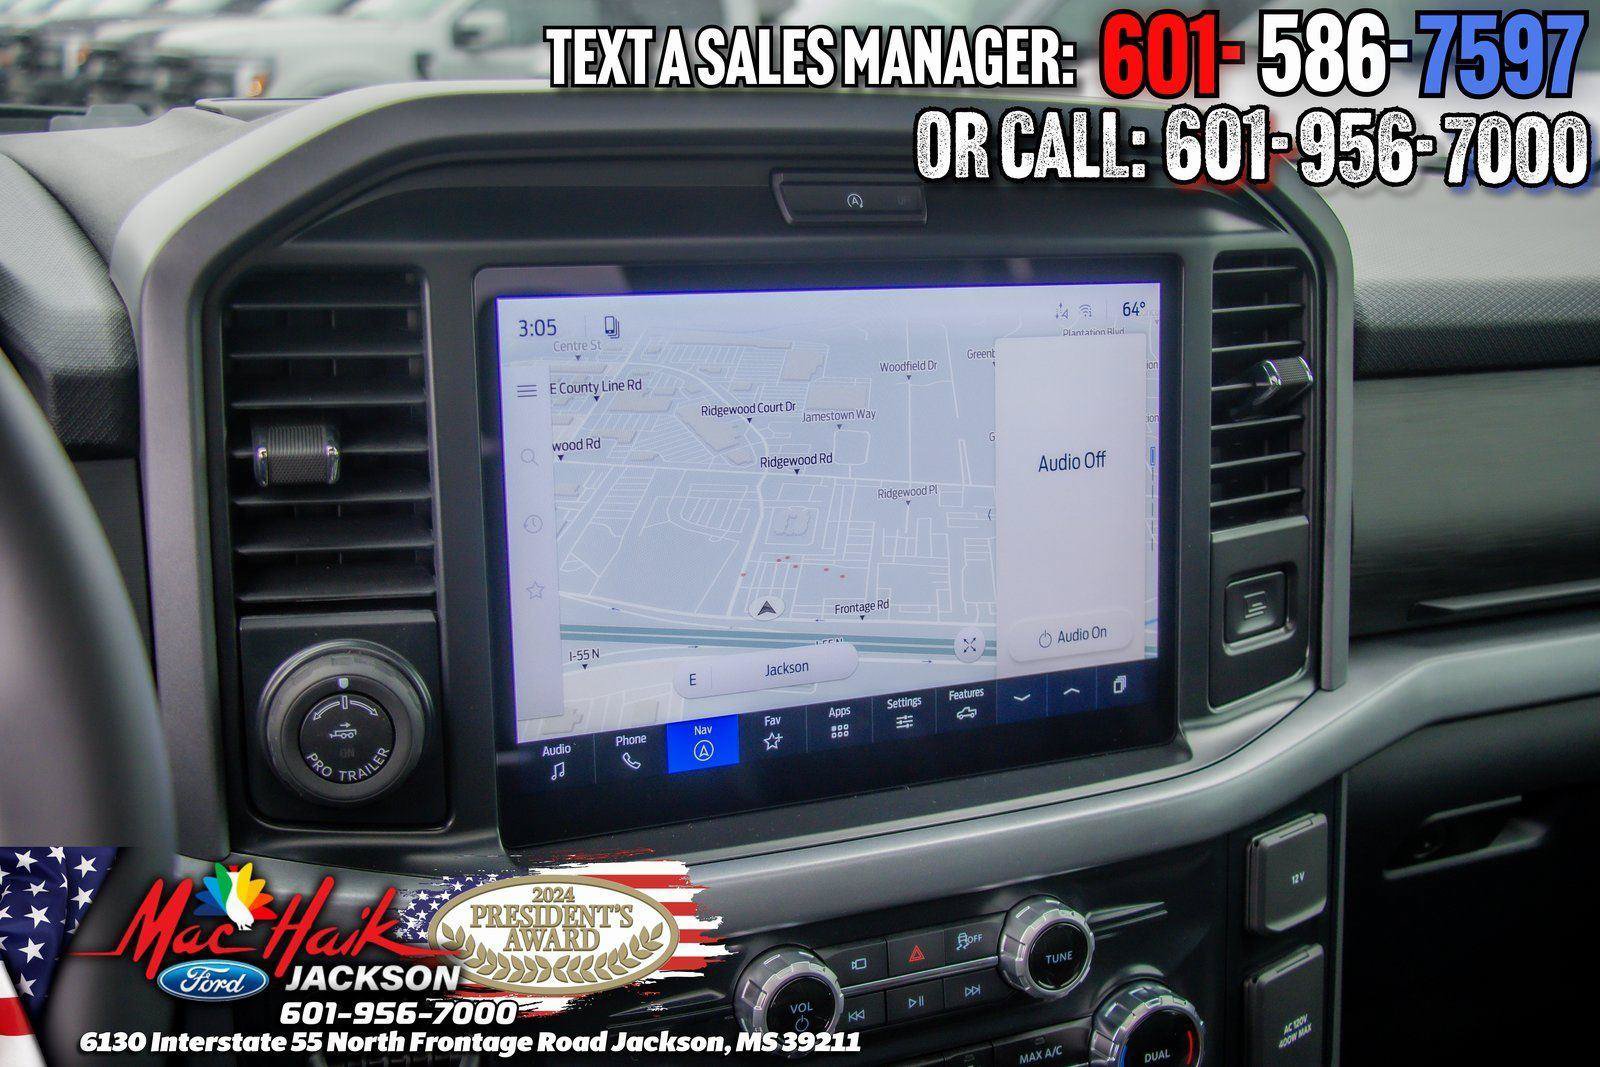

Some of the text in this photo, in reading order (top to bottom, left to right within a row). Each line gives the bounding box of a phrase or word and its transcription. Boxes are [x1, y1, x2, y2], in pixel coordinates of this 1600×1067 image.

[518, 318, 558, 337] 3:05
[553, 339, 602, 353] Centre St
[880, 360, 938, 373] Woodfield Dr
[550, 379, 642, 396] E County Line Rd
[701, 401, 796, 418] Ridgewood Court Dr
[802, 408, 876, 423] Jamestown Way
[552, 437, 601, 452] wood Rd
[760, 453, 833, 469] Ridgewood Rd
[1038, 450, 1107, 473] Audio Off
[877, 484, 938, 500] Ridgewood Pl
[834, 599, 890, 616] Frontage Rd
[1057, 626, 1107, 644] Audio On
[569, 649, 600, 662] I-55 N
[689, 661, 809, 686] E Jackson
[949, 687, 985, 701] Features
[887, 695, 922, 711] Settings
[828, 705, 851, 719] Apps
[764, 714, 781, 727] Fav
[694, 724, 712, 736] Nav
[615, 733, 646, 747] Phone
[542, 743, 572, 757] Audio
[307, 747, 391, 782] PRO TRAILER
[1291, 871, 1305, 885] 12V
[966, 932, 983, 945] OFF
[1045, 950, 1073, 964] TUNE
[790, 1000, 814, 1014] VOL
[1019, 1044, 1063, 1065] MAX A/C
[1144, 1049, 1170, 1063] DUAL
